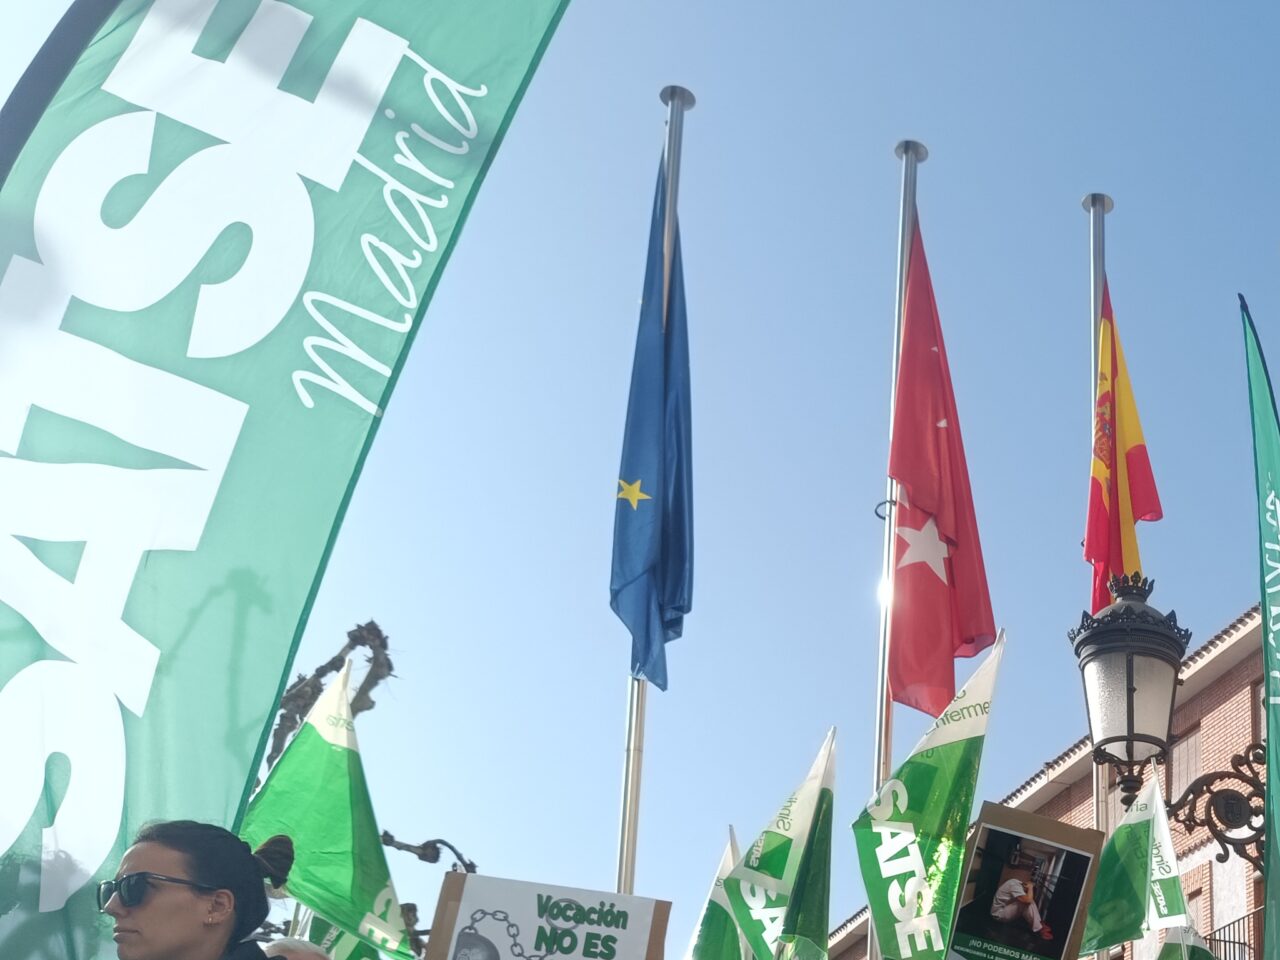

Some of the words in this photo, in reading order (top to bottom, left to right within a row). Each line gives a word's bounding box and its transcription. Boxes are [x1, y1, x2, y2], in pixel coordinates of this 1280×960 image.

[291, 42, 488, 418] Madrid
[866, 779, 945, 959] SATSE
[537, 893, 629, 930] Vocación
[534, 925, 578, 955] NO
[582, 931, 618, 960] ES
[982, 942, 1021, 959] PODEMOS
